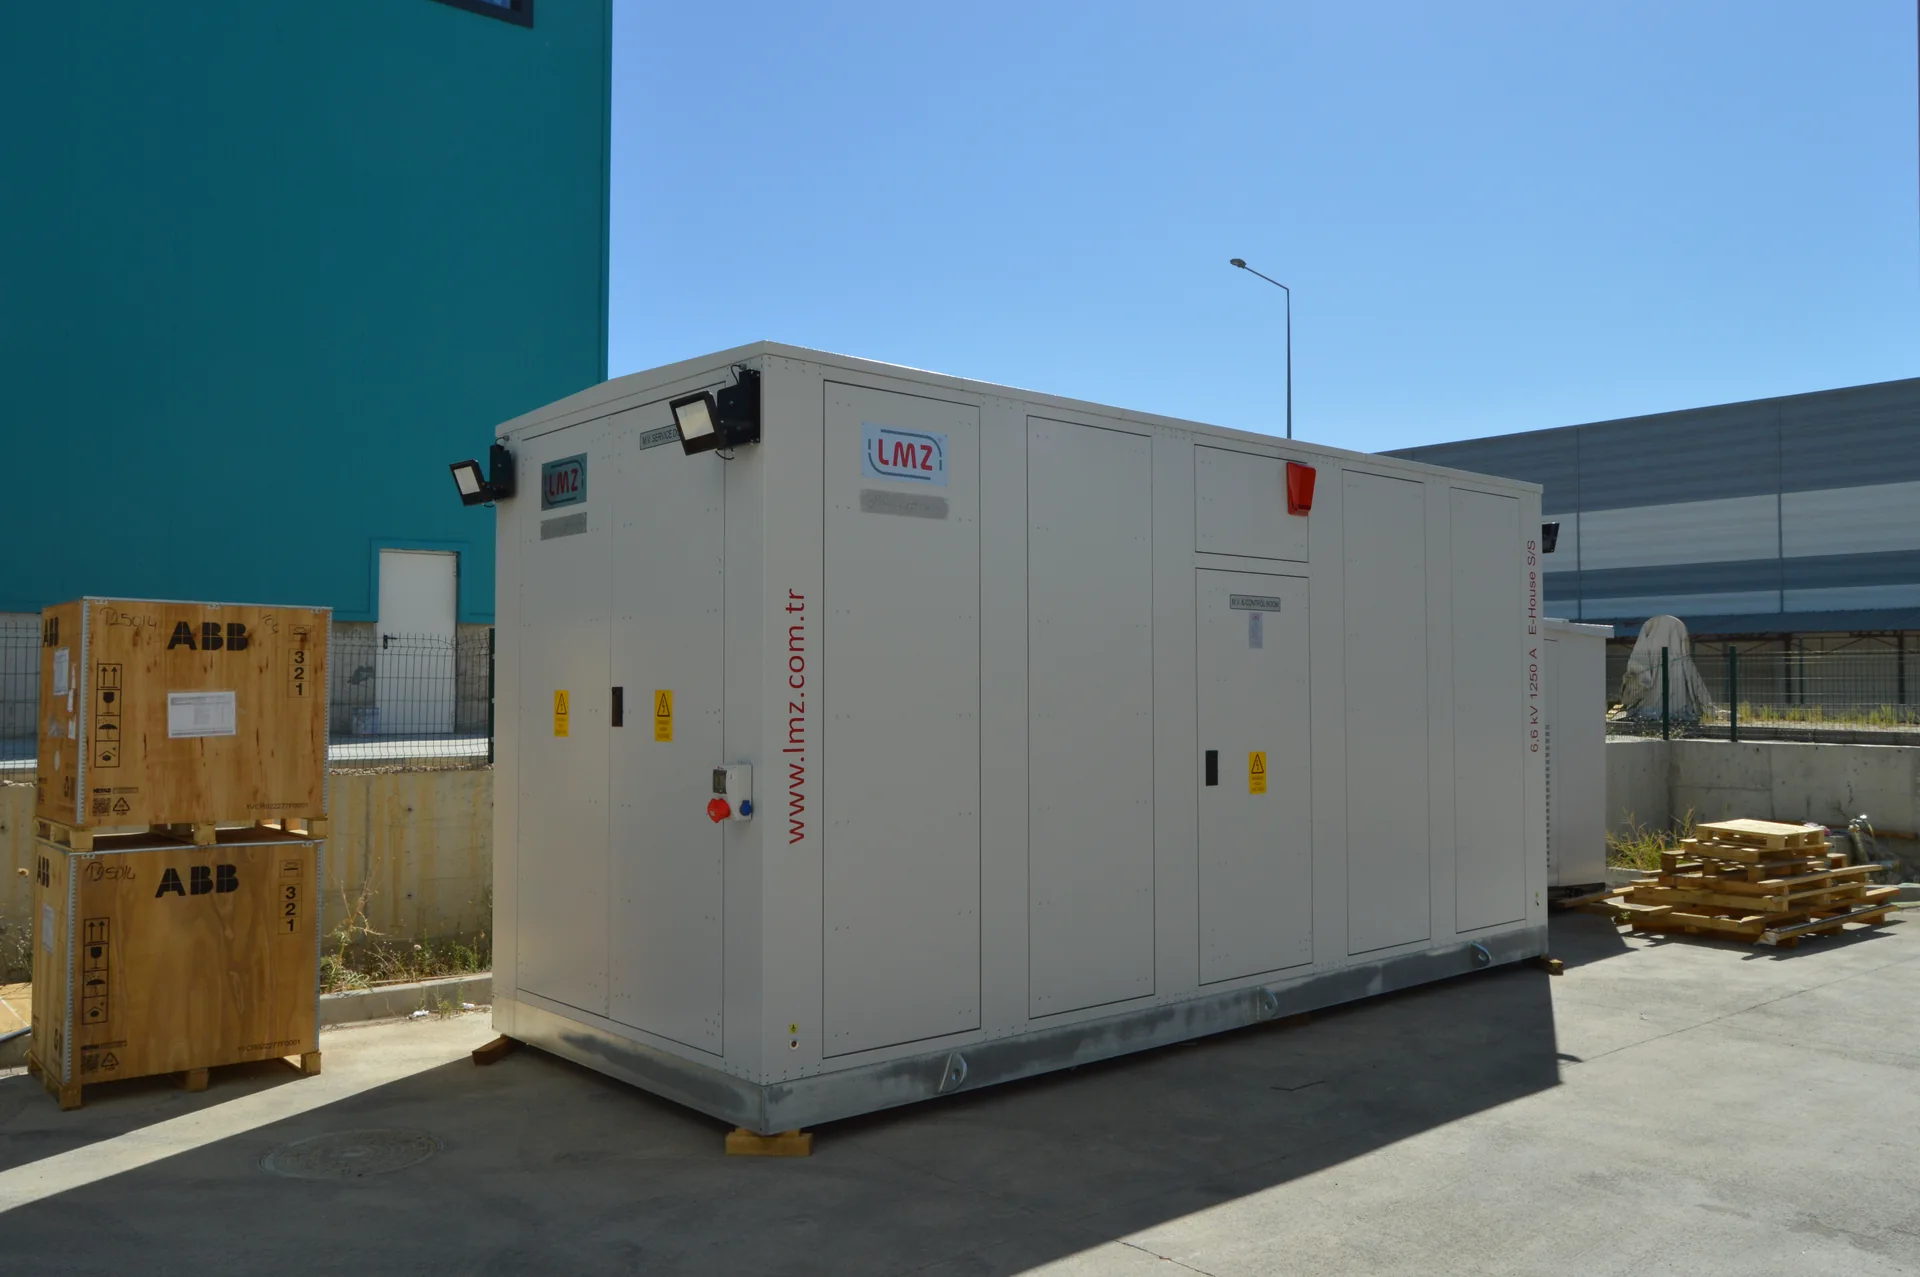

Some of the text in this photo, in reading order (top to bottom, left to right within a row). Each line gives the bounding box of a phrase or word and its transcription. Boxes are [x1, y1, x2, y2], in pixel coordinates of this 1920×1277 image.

[651, 429, 672, 442] SERVICE
[878, 438, 933, 472] LMZ
[548, 468, 579, 497] LMZ
[1527, 539, 1536, 567] S/S
[1528, 571, 1537, 636] E-House
[42, 616, 60, 648] ABB
[166, 621, 249, 651] ABB
[294, 651, 305, 664] 3
[1529, 647, 1537, 660] A
[294, 667, 305, 680] 2
[1529, 663, 1538, 699] 1250
[296, 683, 303, 696] 1
[782, 588, 805, 845] www.lmz.com.tr
[1530, 705, 1539, 725] kV
[36, 855, 50, 889] ABB
[155, 864, 239, 898] ABB
[285, 886, 296, 900] 3
[285, 902, 296, 916] 2
[287, 919, 294, 932] 1
